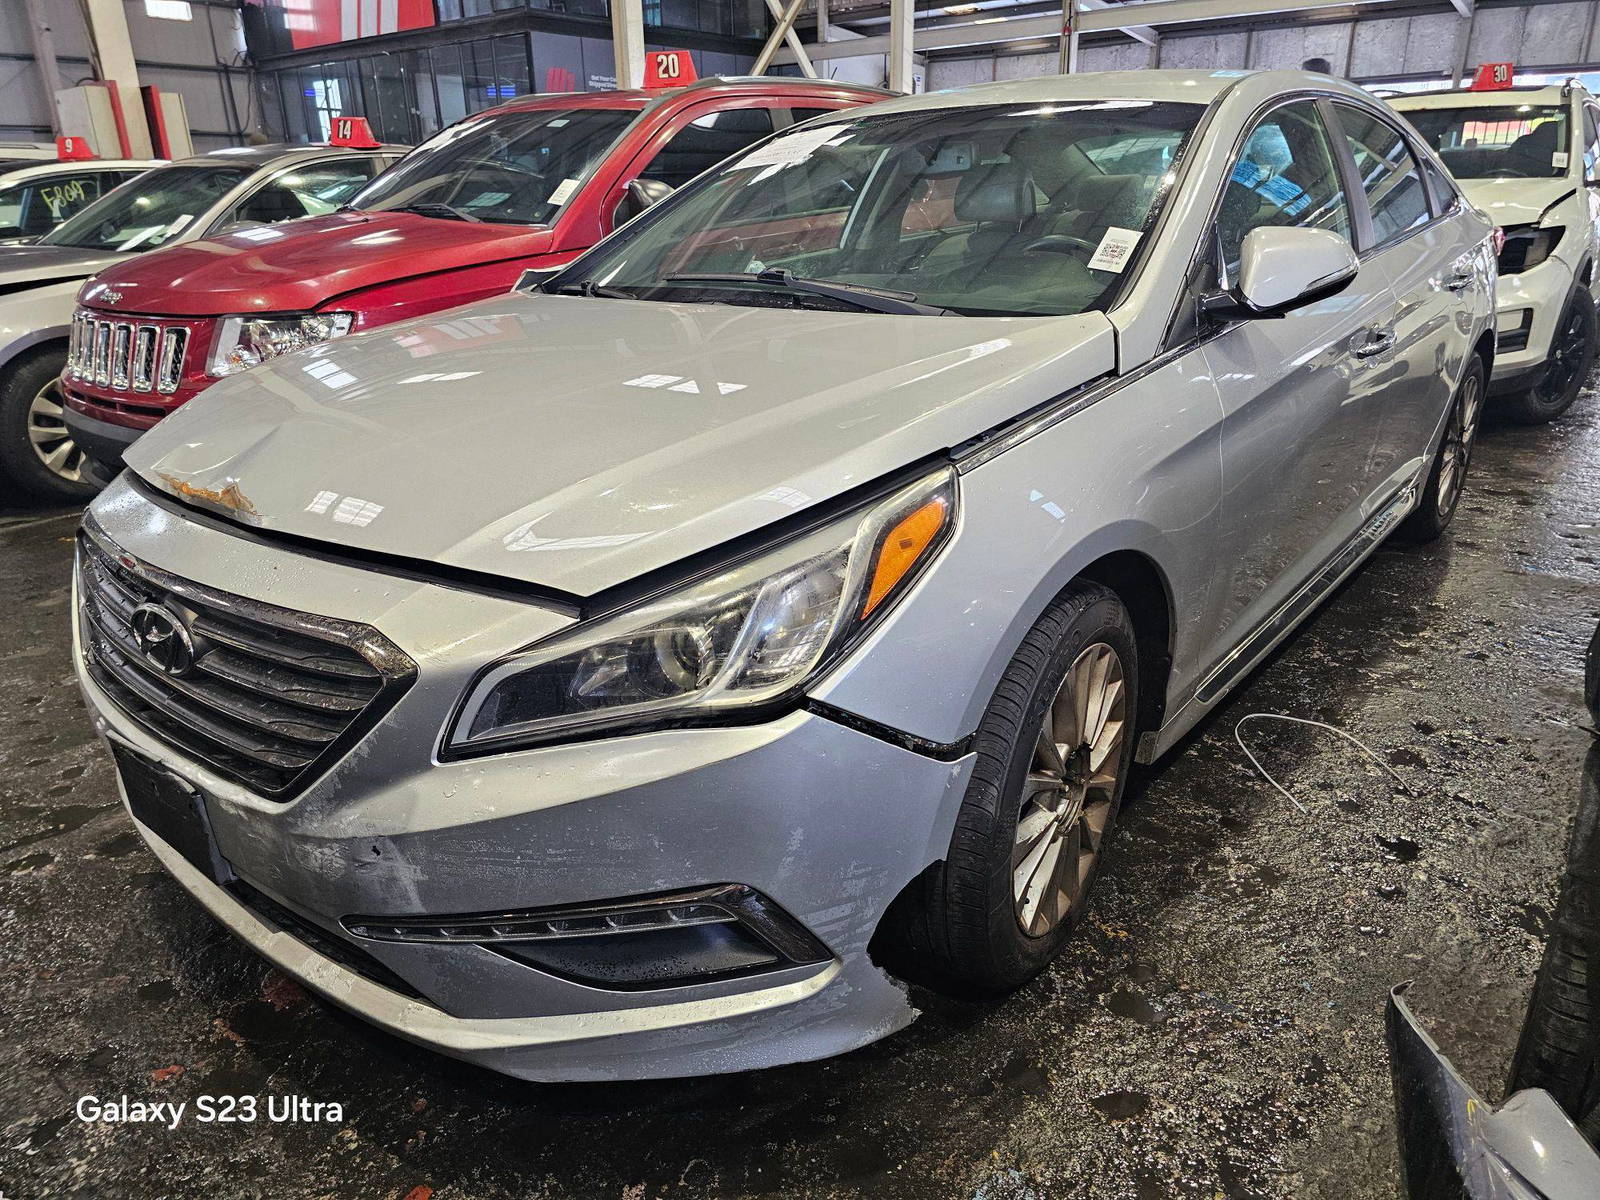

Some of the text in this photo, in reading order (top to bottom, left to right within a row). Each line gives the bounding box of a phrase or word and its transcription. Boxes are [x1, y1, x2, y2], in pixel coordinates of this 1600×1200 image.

[657, 54, 680, 79] 20
[1494, 65, 1507, 83] 30
[338, 119, 352, 139] 14
[65, 138, 73, 153] 9
